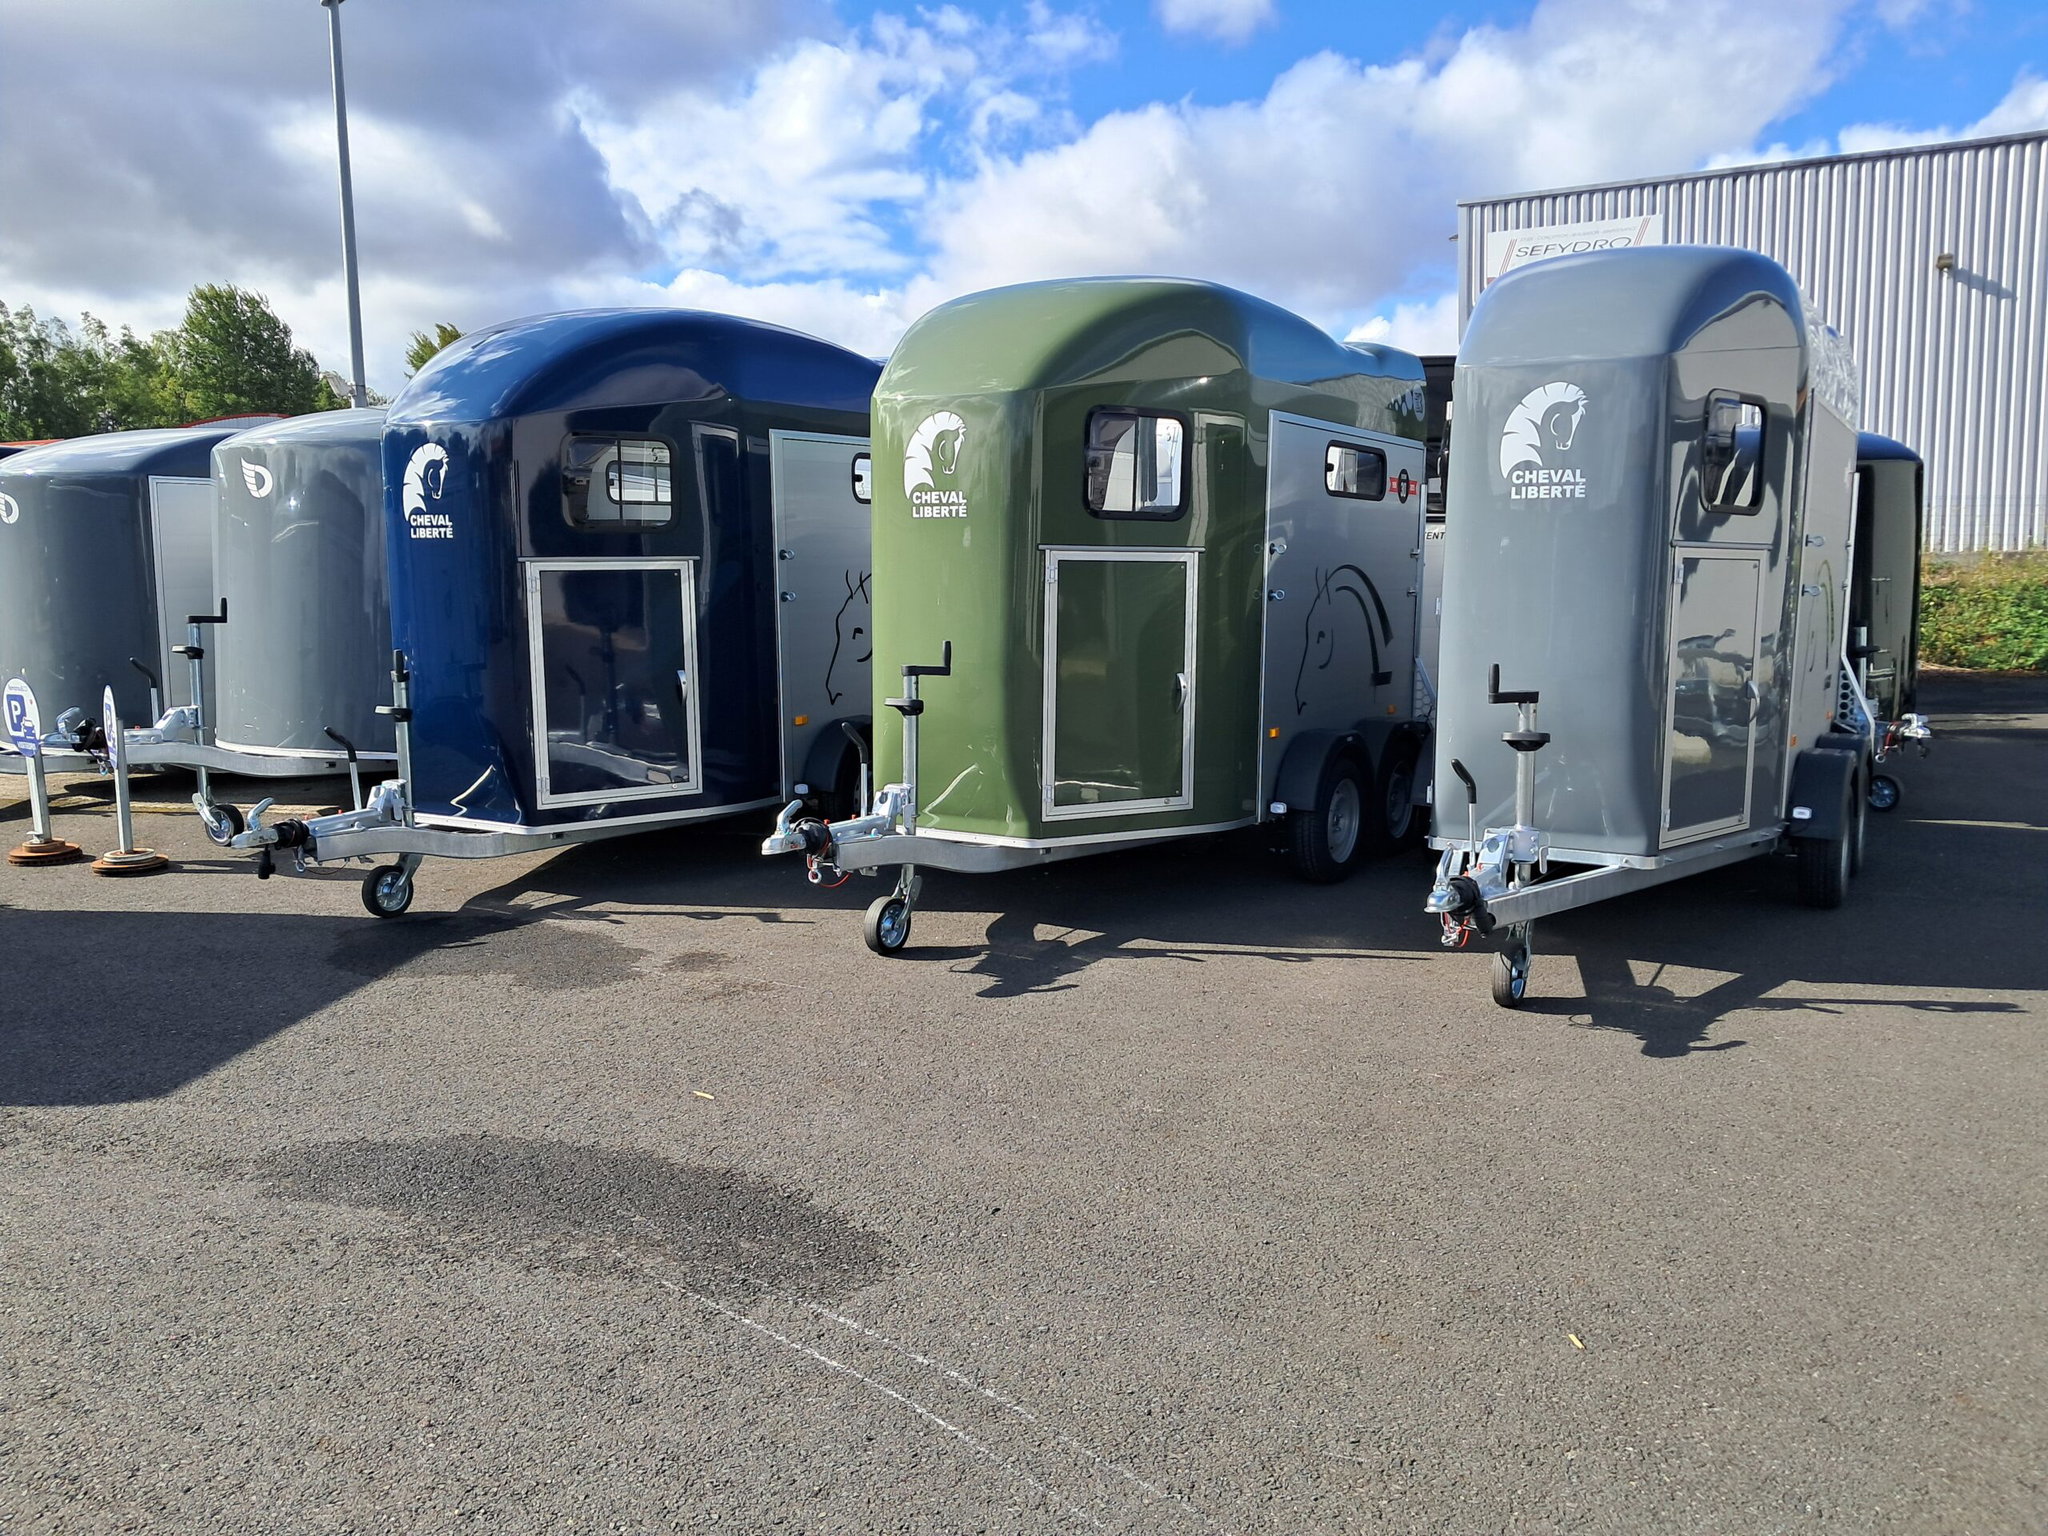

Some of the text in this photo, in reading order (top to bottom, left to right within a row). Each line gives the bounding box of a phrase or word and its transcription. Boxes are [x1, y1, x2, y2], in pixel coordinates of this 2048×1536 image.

[1515, 236, 1632, 258] SEFYDRO
[1511, 469, 1586, 484] CHEVAL
[912, 491, 968, 504] CHEVAL
[1510, 482, 1586, 500] LIBERTÉ
[912, 503, 968, 518] LIBERTÉ
[410, 514, 453, 526] CHEVAL
[410, 525, 454, 539] LIBERTÉ
[1425, 531, 1446, 540] ENT
[10, 700, 21, 724] P
